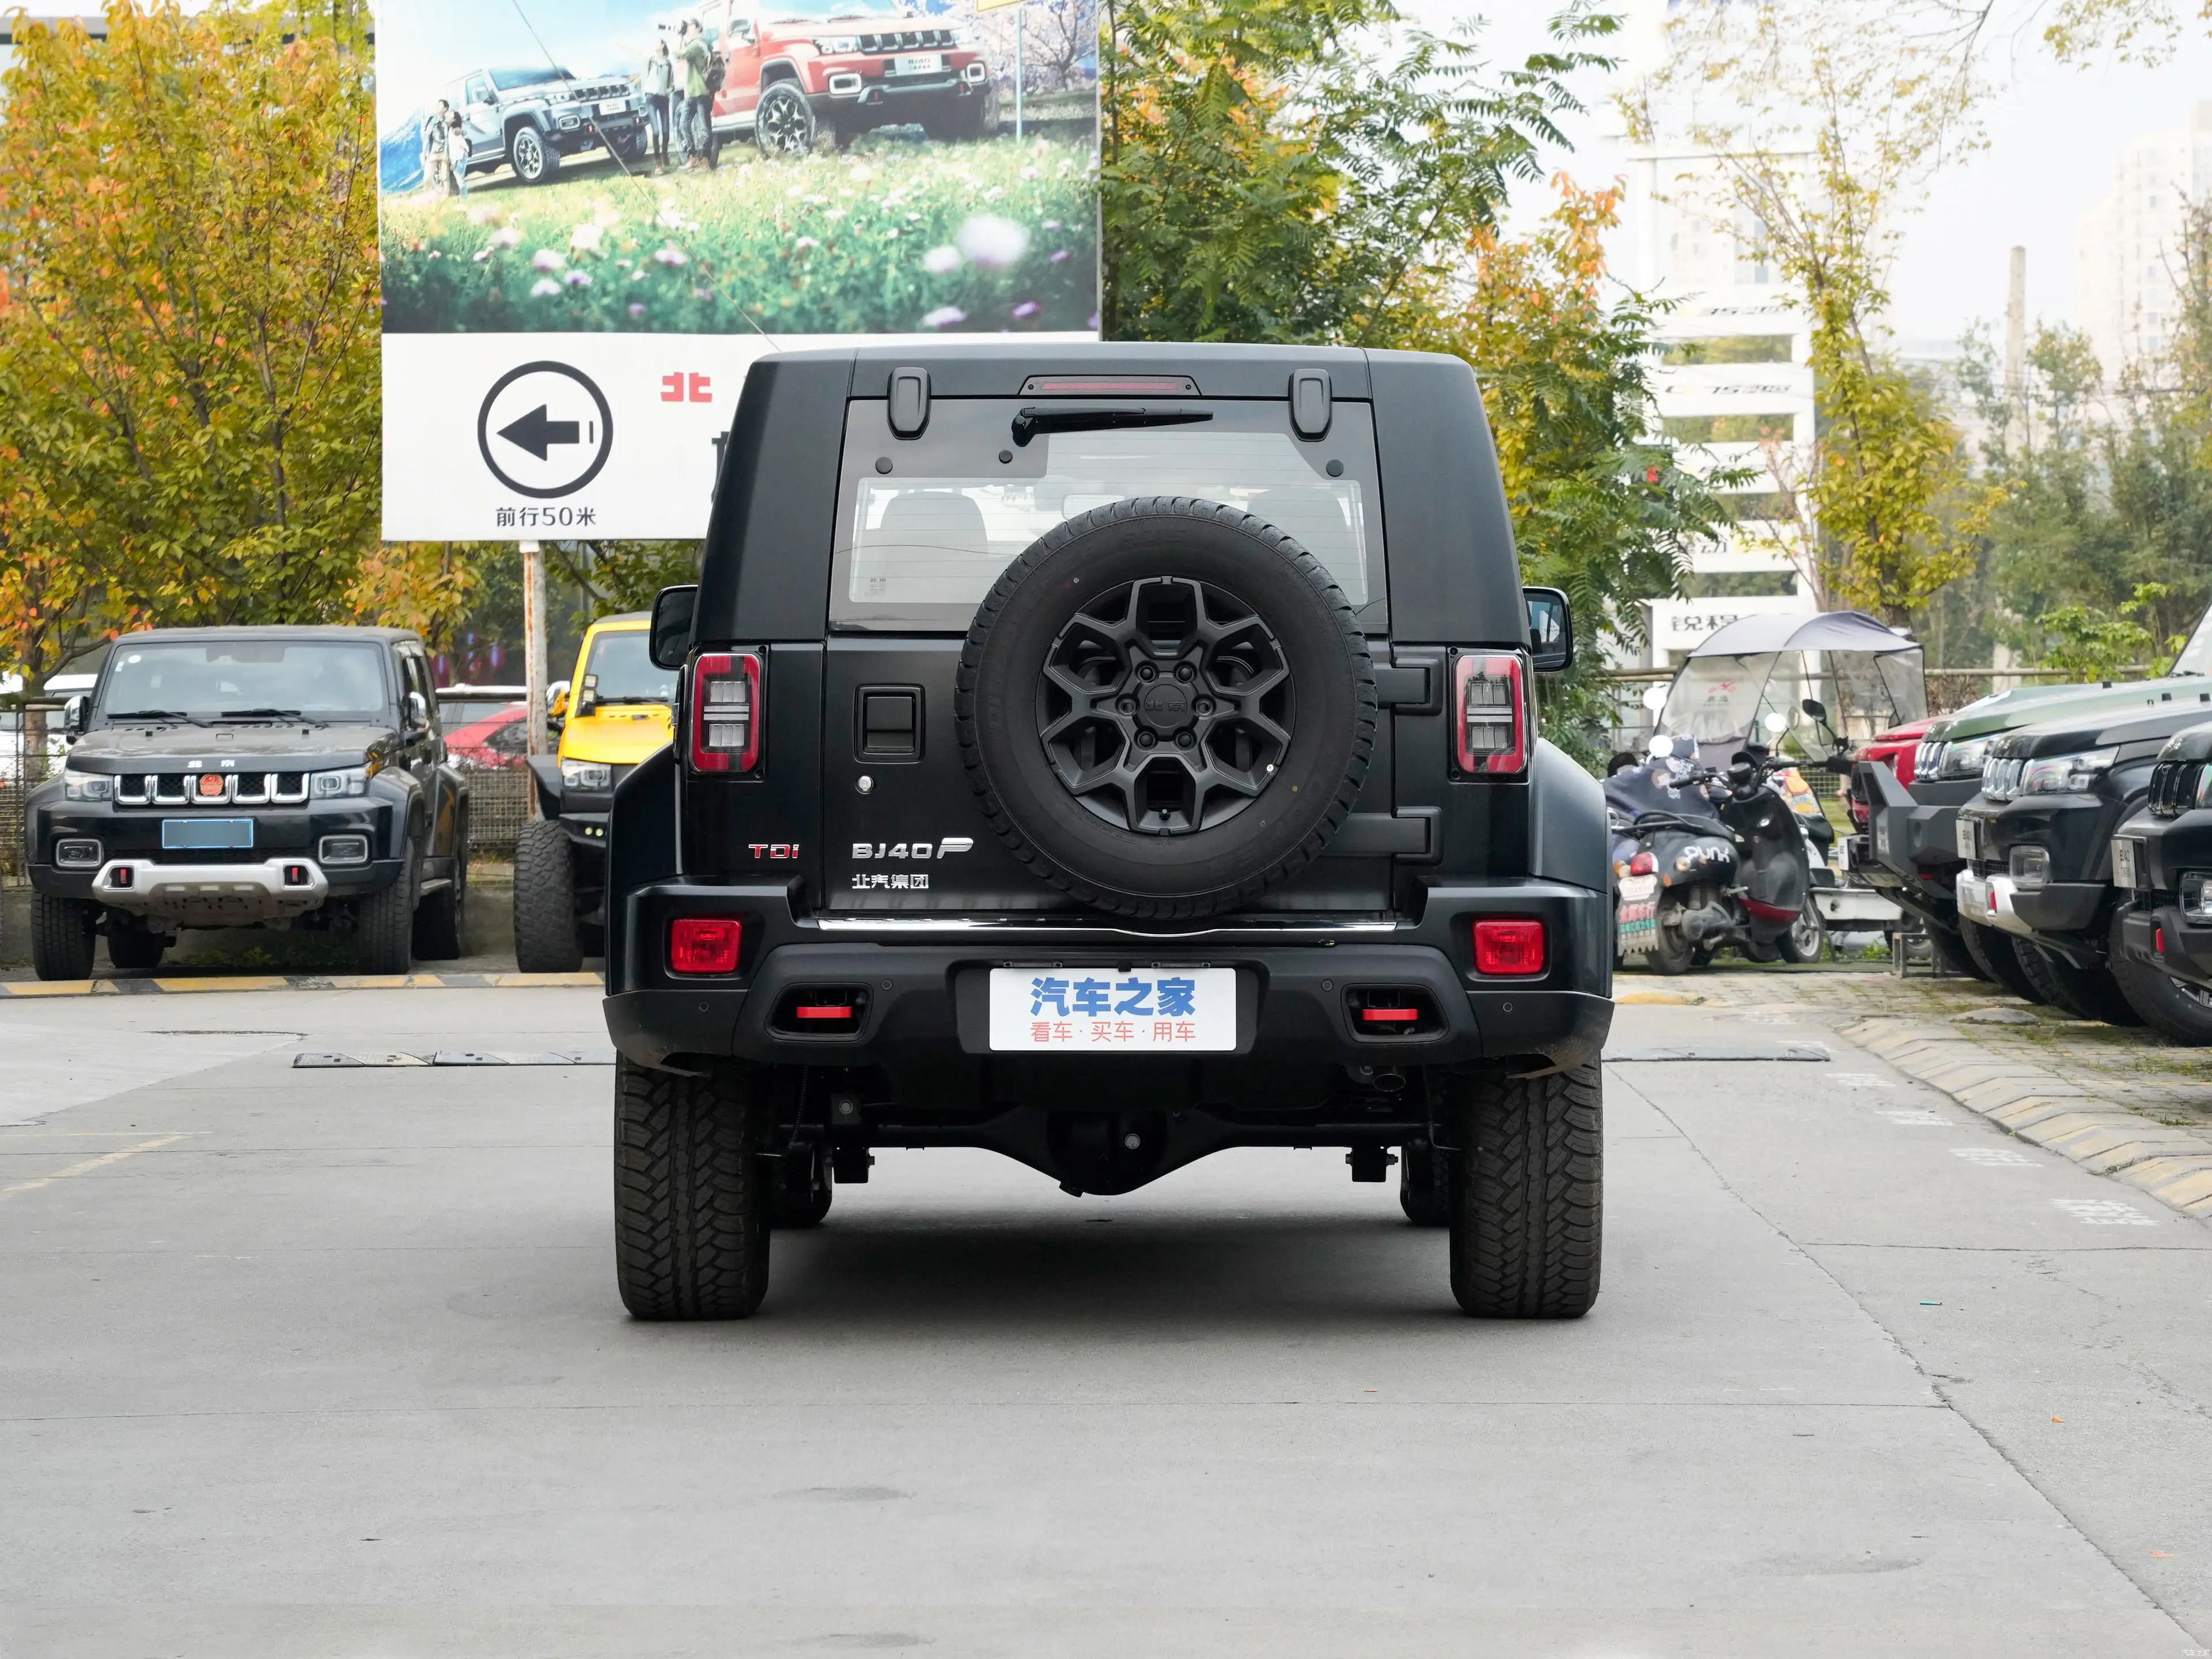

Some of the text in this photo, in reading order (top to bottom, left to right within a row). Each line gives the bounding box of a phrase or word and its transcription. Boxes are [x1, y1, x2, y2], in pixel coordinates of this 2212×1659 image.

[496, 506, 596, 527] 前行50米
[1145, 700, 1185, 712] 北京
[852, 874, 929, 889] 北汽集团
[1030, 977, 1196, 1017] 汽车之家
